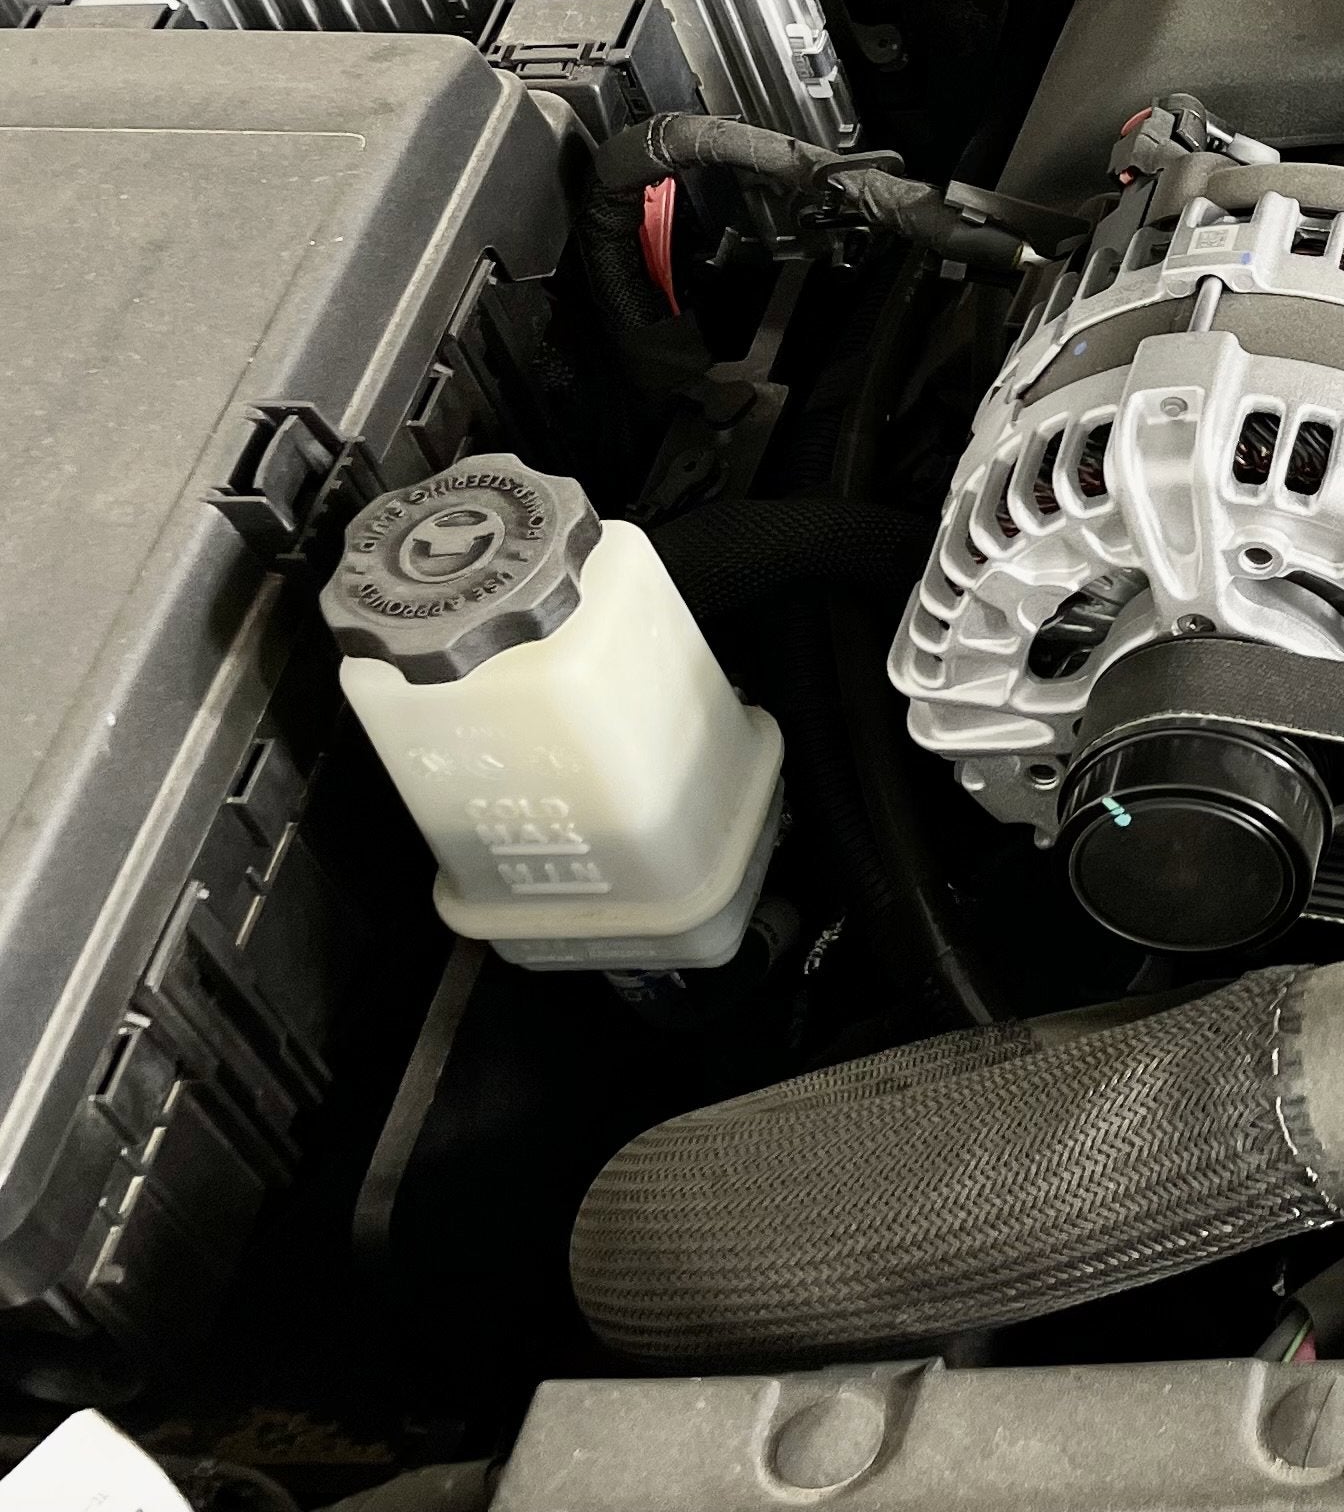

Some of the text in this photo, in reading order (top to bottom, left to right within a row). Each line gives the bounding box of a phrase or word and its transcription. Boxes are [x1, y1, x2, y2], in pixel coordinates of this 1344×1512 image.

[409, 472, 514, 506] STEERING
[471, 570, 515, 603] USE
[465, 796, 571, 819] COLD
[474, 821, 584, 845] MAX
[496, 861, 604, 884] MIN
